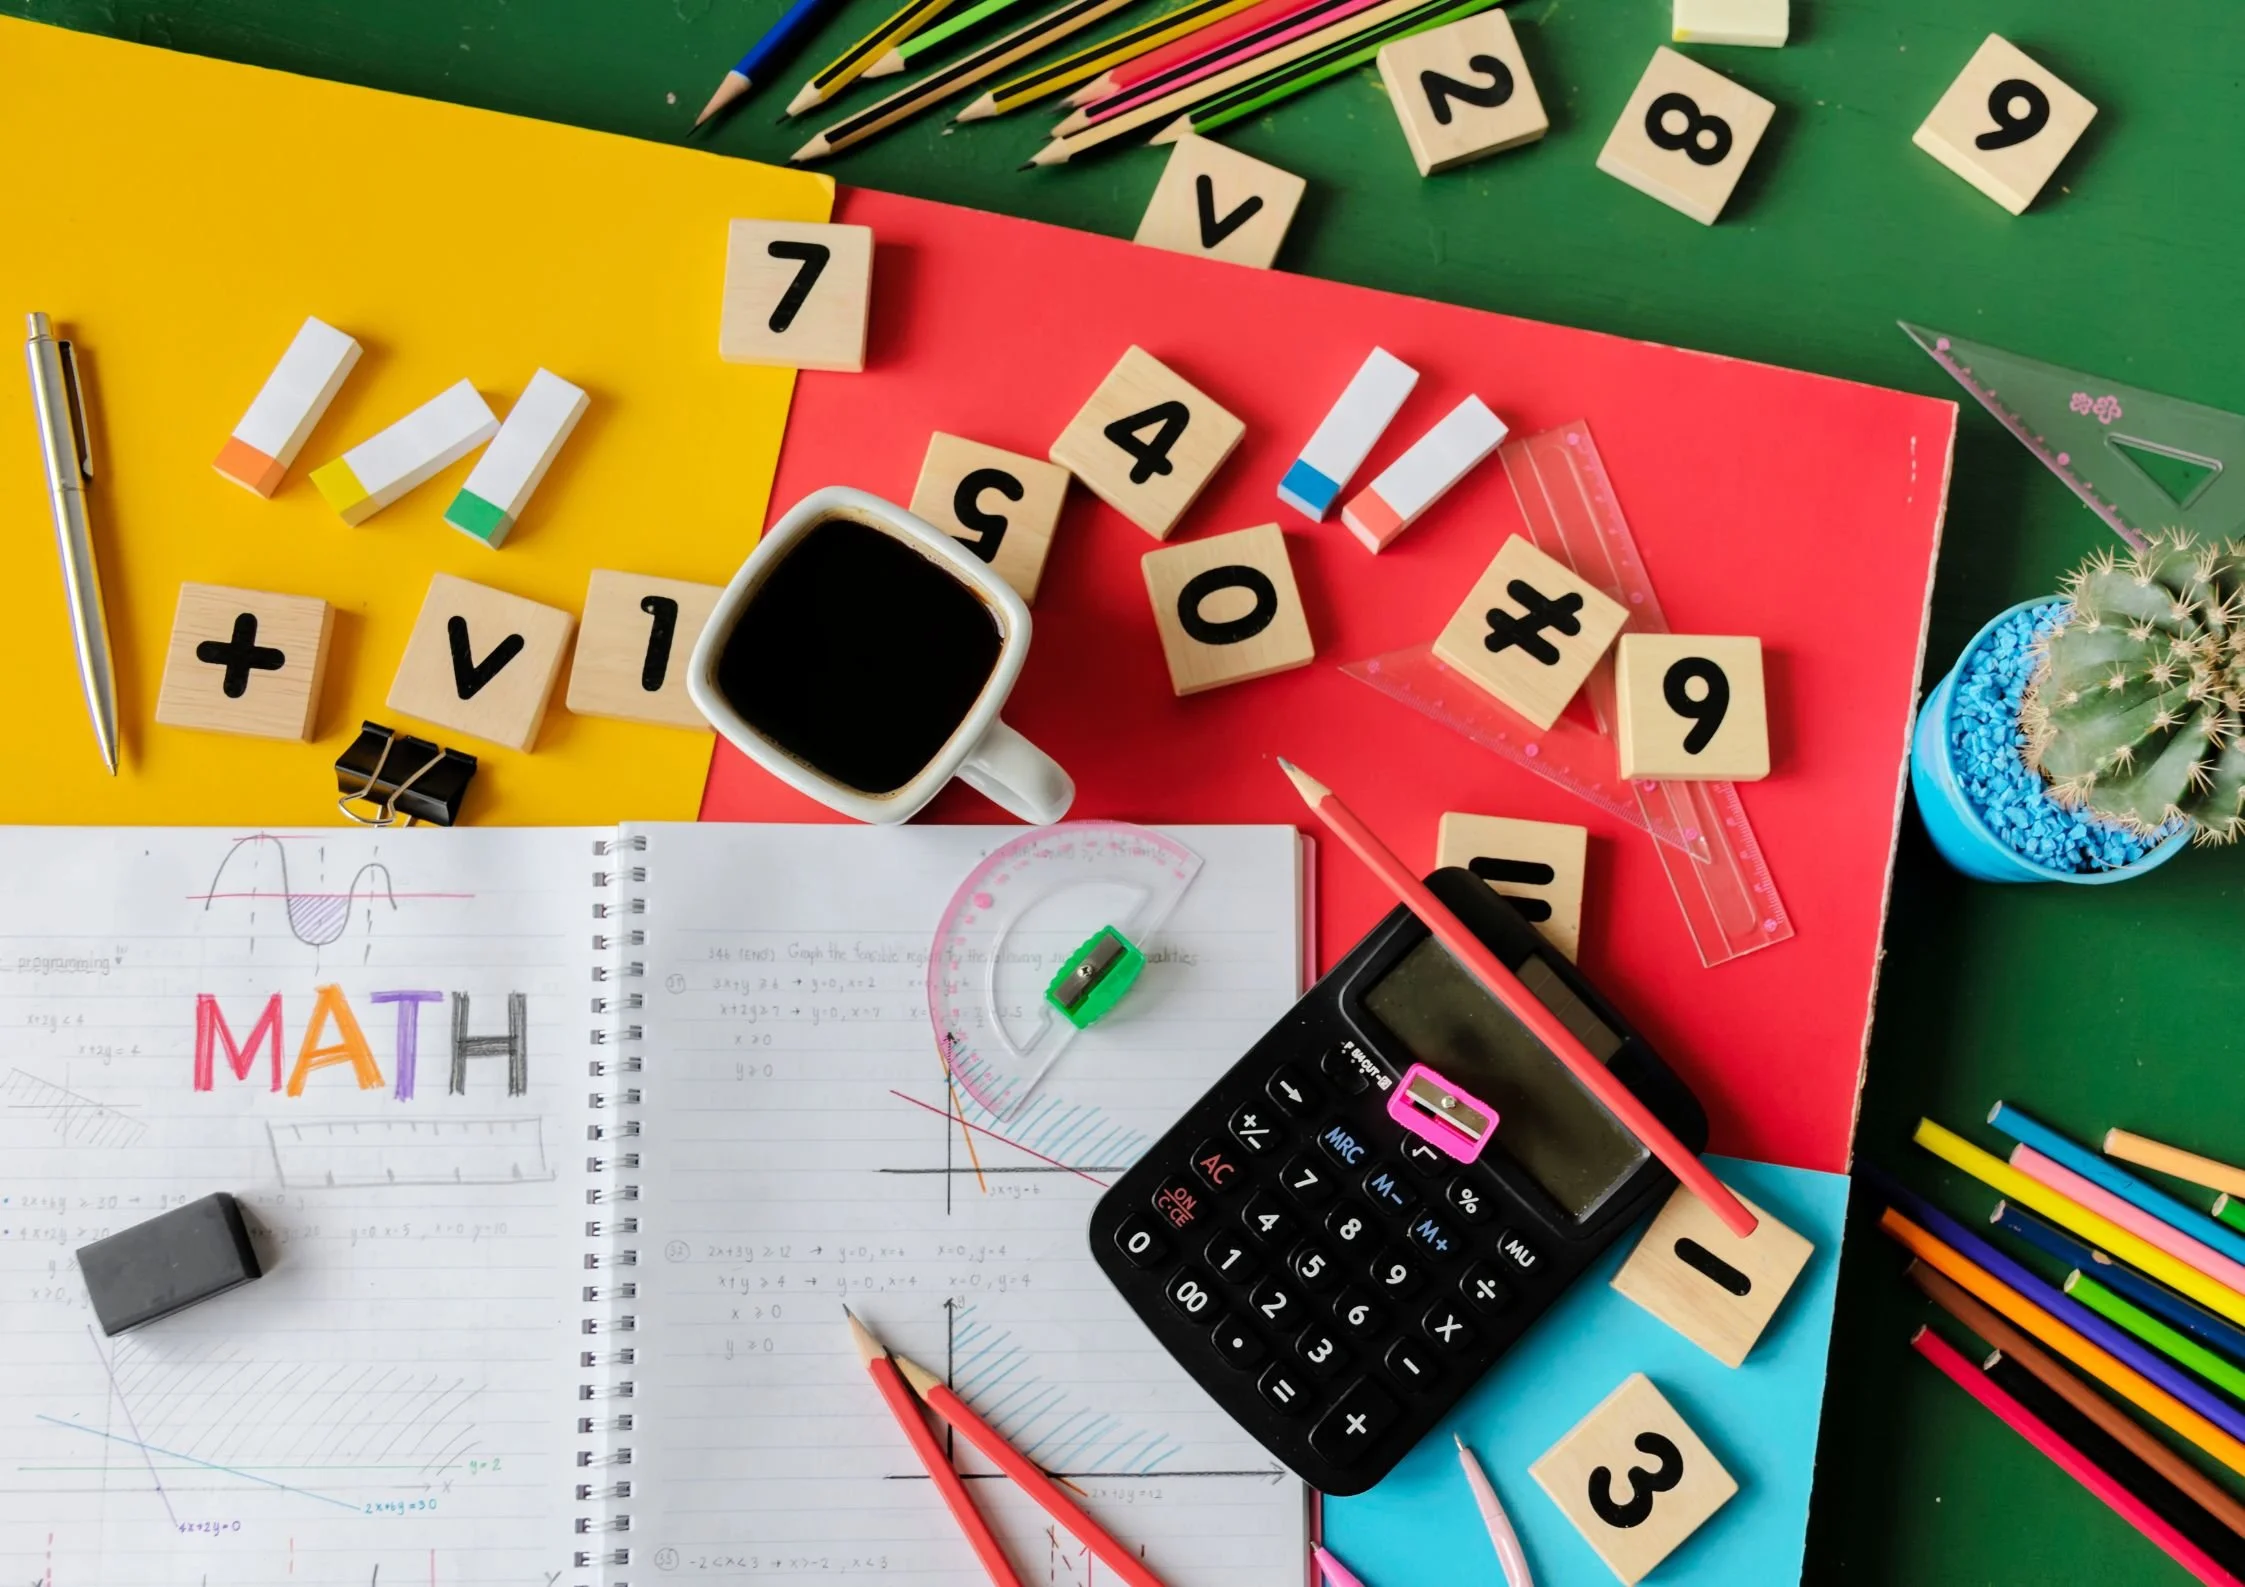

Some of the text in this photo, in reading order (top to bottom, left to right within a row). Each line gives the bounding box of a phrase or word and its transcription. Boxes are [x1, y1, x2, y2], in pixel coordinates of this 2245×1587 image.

[1421, 54, 1531, 125] 2
[1645, 92, 1733, 166] 8
[1975, 79, 2050, 151] 9
[767, 240, 830, 333] 7
[1103, 400, 1190, 485] 4
[951, 468, 1024, 564] 5
[640, 595, 679, 692] 1
[1663, 656, 1730, 755] 9
[17, 950, 111, 976] programming
[193, 983, 528, 1102] MATH
[1324, 1126, 1365, 1164] MRC
[1199, 1154, 1235, 1185] AC
[1294, 1168, 1319, 1189] 7
[1174, 1187, 1197, 1210] ON
[1257, 1213, 1280, 1233] 4
[1339, 1218, 1362, 1241] 8
[1416, 1219, 1449, 1252] M+
[1128, 1231, 1151, 1254] 0
[1504, 1238, 1536, 1268] MU
[1221, 1249, 1242, 1270] 1
[1301, 1254, 1326, 1278] 5
[1385, 1263, 1407, 1285] 9
[1176, 1281, 1208, 1313] 00
[1260, 1291, 1287, 1319] 2
[1348, 1305, 1370, 1326] 6
[1307, 1338, 1333, 1363] 3
[1588, 1431, 1684, 1529] 3
